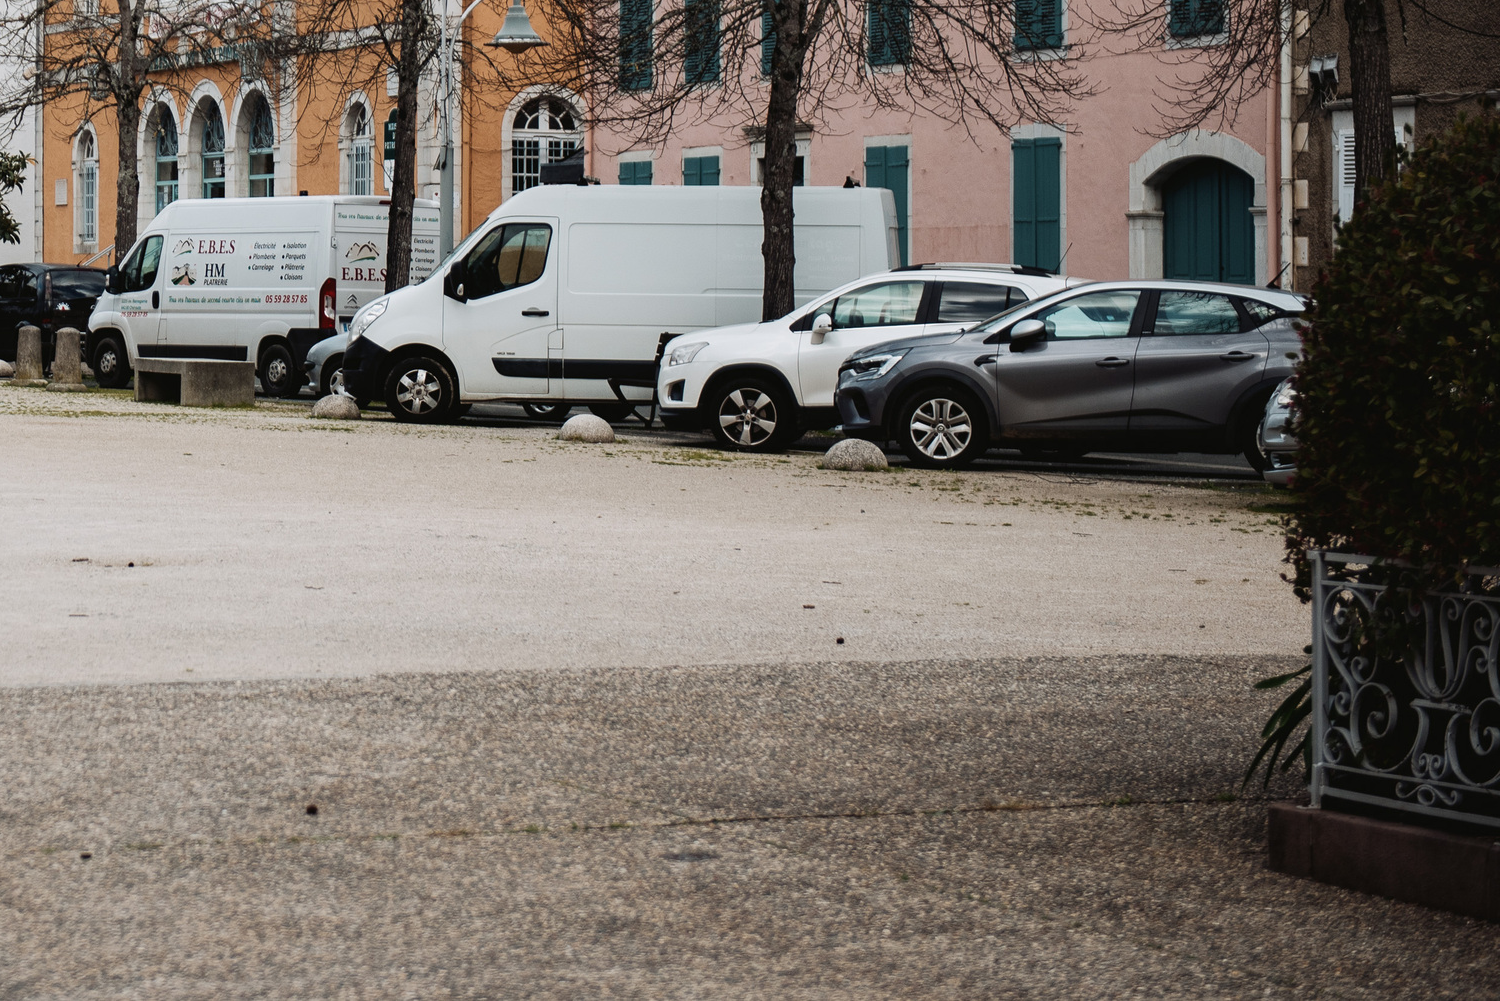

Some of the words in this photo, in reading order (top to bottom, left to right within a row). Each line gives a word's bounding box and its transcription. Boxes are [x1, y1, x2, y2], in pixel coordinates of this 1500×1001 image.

[253, 241, 277, 250] Électricité
[413, 237, 434, 245] Électricité
[198, 239, 236, 255] E.B.E.S
[285, 253, 306, 261] Parquets
[415, 257, 435, 265] Carrelage
[204, 263, 226, 278] HM
[251, 263, 275, 272] Carrelage
[284, 263, 305, 271] Plâtrerie
[341, 267, 387, 282] E.B.E.S
[203, 278, 228, 286] PLATRERIE
[265, 294, 273, 304] 05
[273, 294, 282, 304] 59
[282, 294, 290, 304] 28
[291, 294, 299, 304] 57
[299, 294, 308, 304] 85
